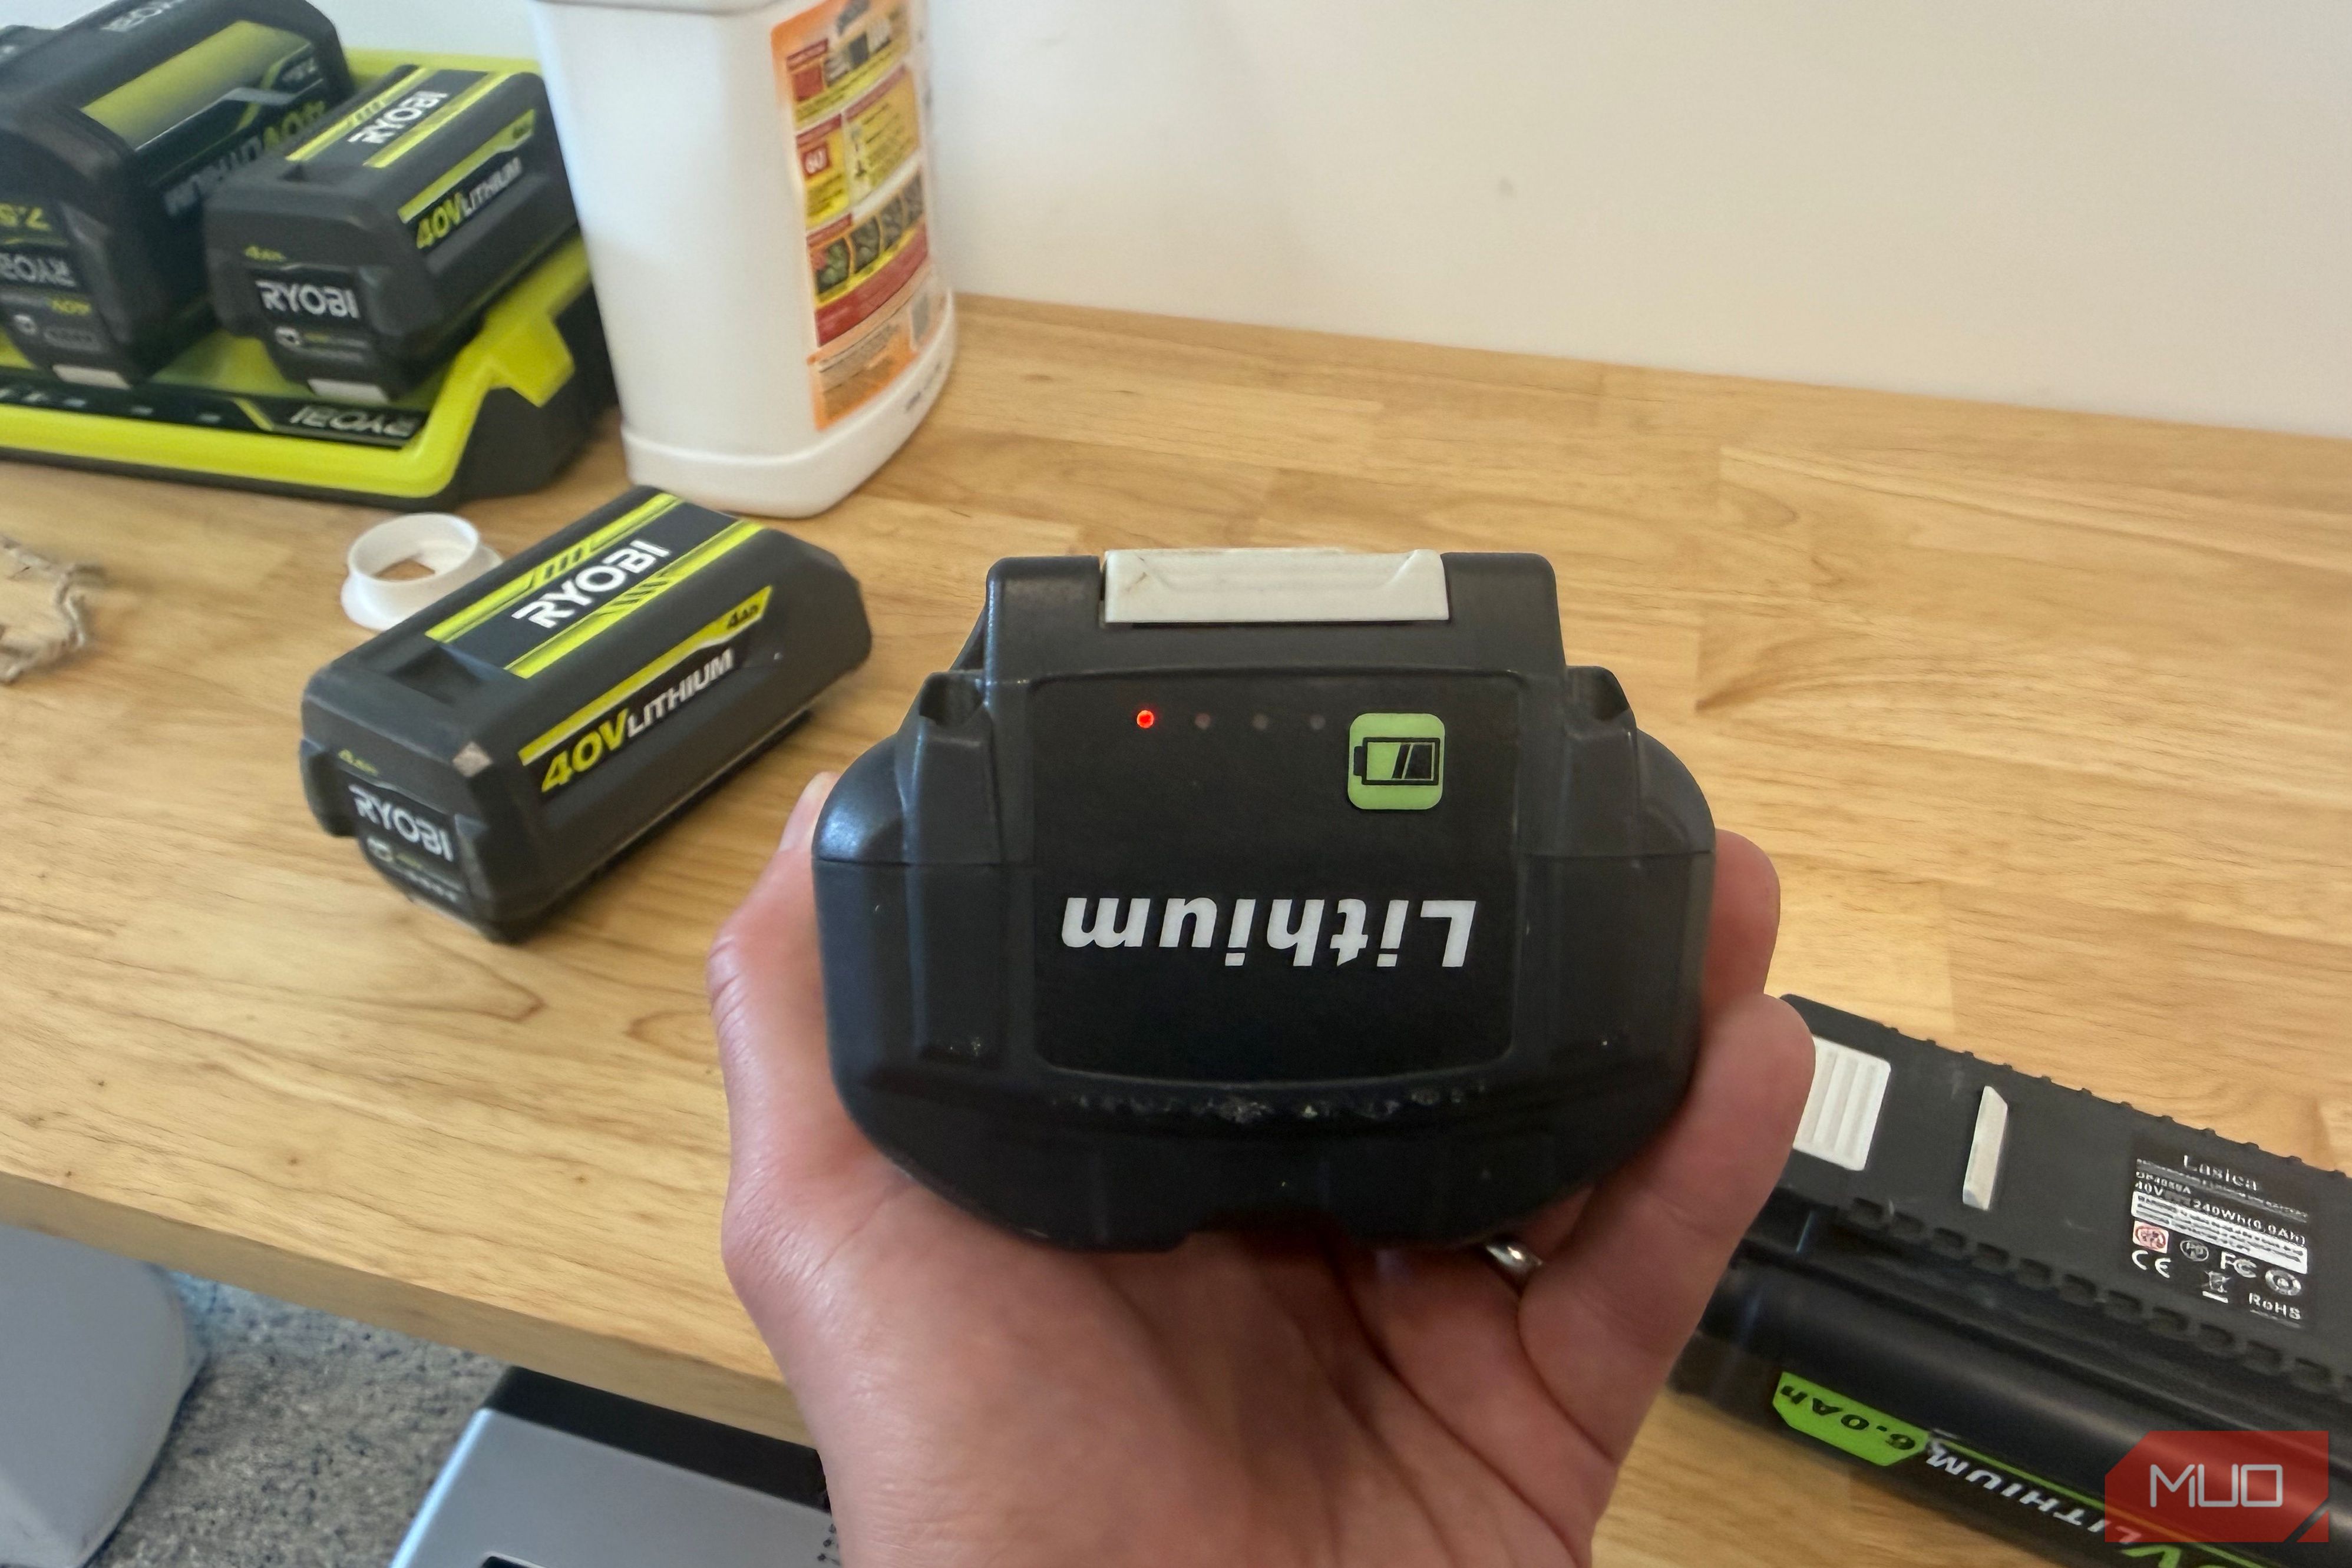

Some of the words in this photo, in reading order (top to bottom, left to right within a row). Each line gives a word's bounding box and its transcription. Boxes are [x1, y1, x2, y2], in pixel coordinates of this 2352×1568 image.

[346, 90, 449, 144] RYOBI
[255, 279, 360, 319] RYOBI
[511, 539, 672, 628] RYOBI
[348, 784, 454, 863] RYOBI
[1062, 897, 1476, 967] Lithium
[2248, 1292, 2301, 1321] RoHS
